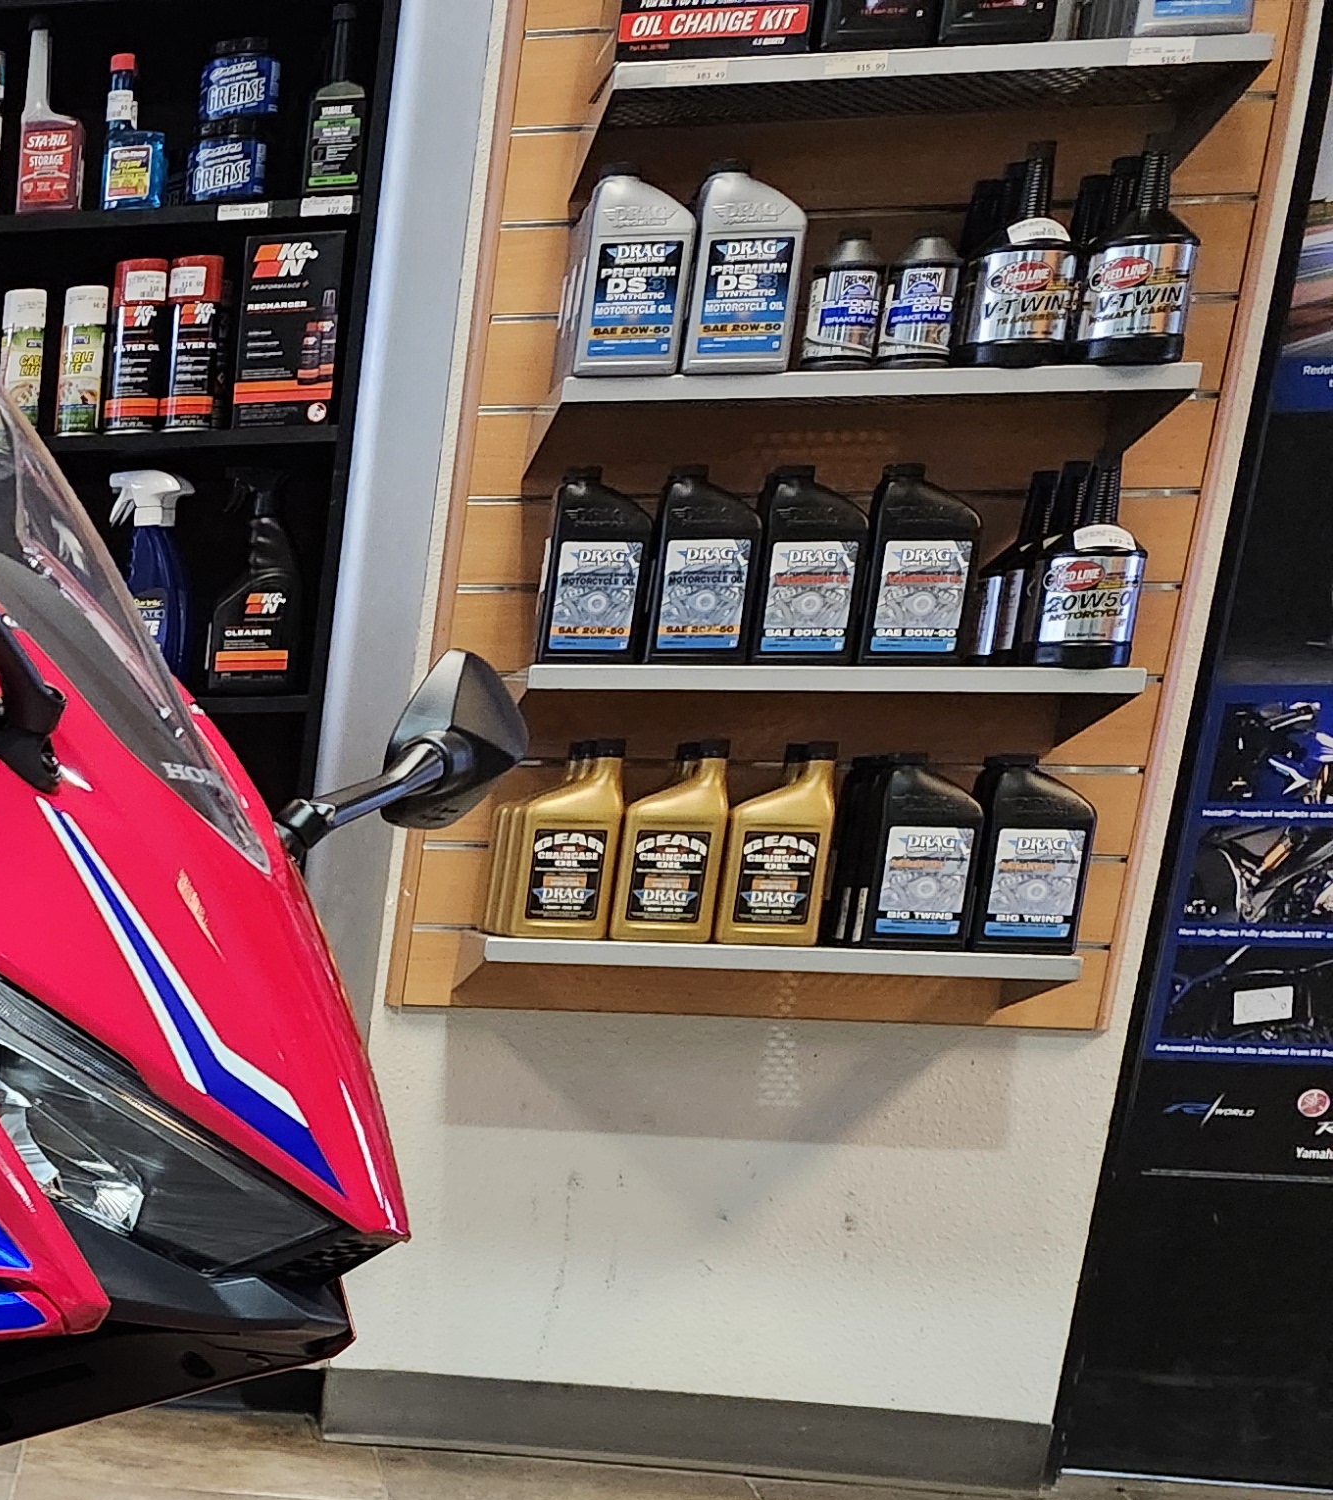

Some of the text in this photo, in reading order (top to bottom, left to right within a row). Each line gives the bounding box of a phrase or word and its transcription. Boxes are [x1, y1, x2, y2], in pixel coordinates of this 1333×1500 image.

[632, 7, 800, 37] OIL CHANGE KIT
[207, 77, 266, 113] GREASE
[26, 133, 69, 148] STA-BIL
[28, 154, 64, 168] STORAGE
[192, 159, 252, 195] GREASE
[617, 243, 666, 258] DRAG
[727, 240, 777, 255] DRAG
[600, 266, 677, 279] PREMIUM
[710, 263, 788, 276] PREMIUM
[1004, 267, 1050, 285] RED LINE
[1102, 263, 1149, 284] RED LINE
[606, 277, 667, 294] DS3
[717, 274, 778, 291] DS3
[606, 292, 665, 301] SYNTHETIC
[716, 289, 776, 298] SYNTHETIC
[246, 301, 308, 312] RECHARGER
[594, 304, 673, 316] MOTORCYCLE OIL
[704, 301, 784, 313] MOTORCYCLE OIL
[890, 313, 947, 325] BRAKE FLUID
[592, 325, 670, 336] SAE 20W-50
[702, 323, 782, 333] SAE 20W-50
[579, 550, 627, 563] DRAG
[686, 547, 734, 560] DRAG
[788, 549, 838, 563] DRAG
[902, 548, 951, 562] DRAG
[668, 575, 729, 586] MOTORCYCLE
[1079, 568, 1100, 580] LINE
[561, 576, 620, 586] MOTORCYCLE
[1048, 608, 1123, 622] MOTORCYCLE
[224, 628, 272, 638] CLEANER
[582, 627, 625, 635] 20W-50
[666, 626, 688, 634] SAE
[764, 629, 790, 637] SAE
[875, 628, 901, 637] SAE
[534, 833, 604, 855] GEAR
[636, 834, 707, 856] GEAR
[743, 835, 816, 857] GEAR
[537, 851, 598, 861] CHAINCASE
[638, 853, 701, 863] CHAINCASE
[746, 854, 810, 864] CHAINCASE
[554, 860, 580, 868] OIL
[542, 888, 585, 901] DRAG
[643, 889, 687, 902] DRAG
[886, 910, 953, 921] BIG TWINS
[995, 914, 1064, 923] BIG TWINS
[1240, 929, 1260, 938] Fully
[1155, 1043, 1194, 1052] Advanced
[1195, 1044, 1234, 1054] Electronic
[1236, 1046, 1256, 1055] Suite
[1258, 1047, 1289, 1056] Derived
[1290, 1048, 1309, 1056] from
